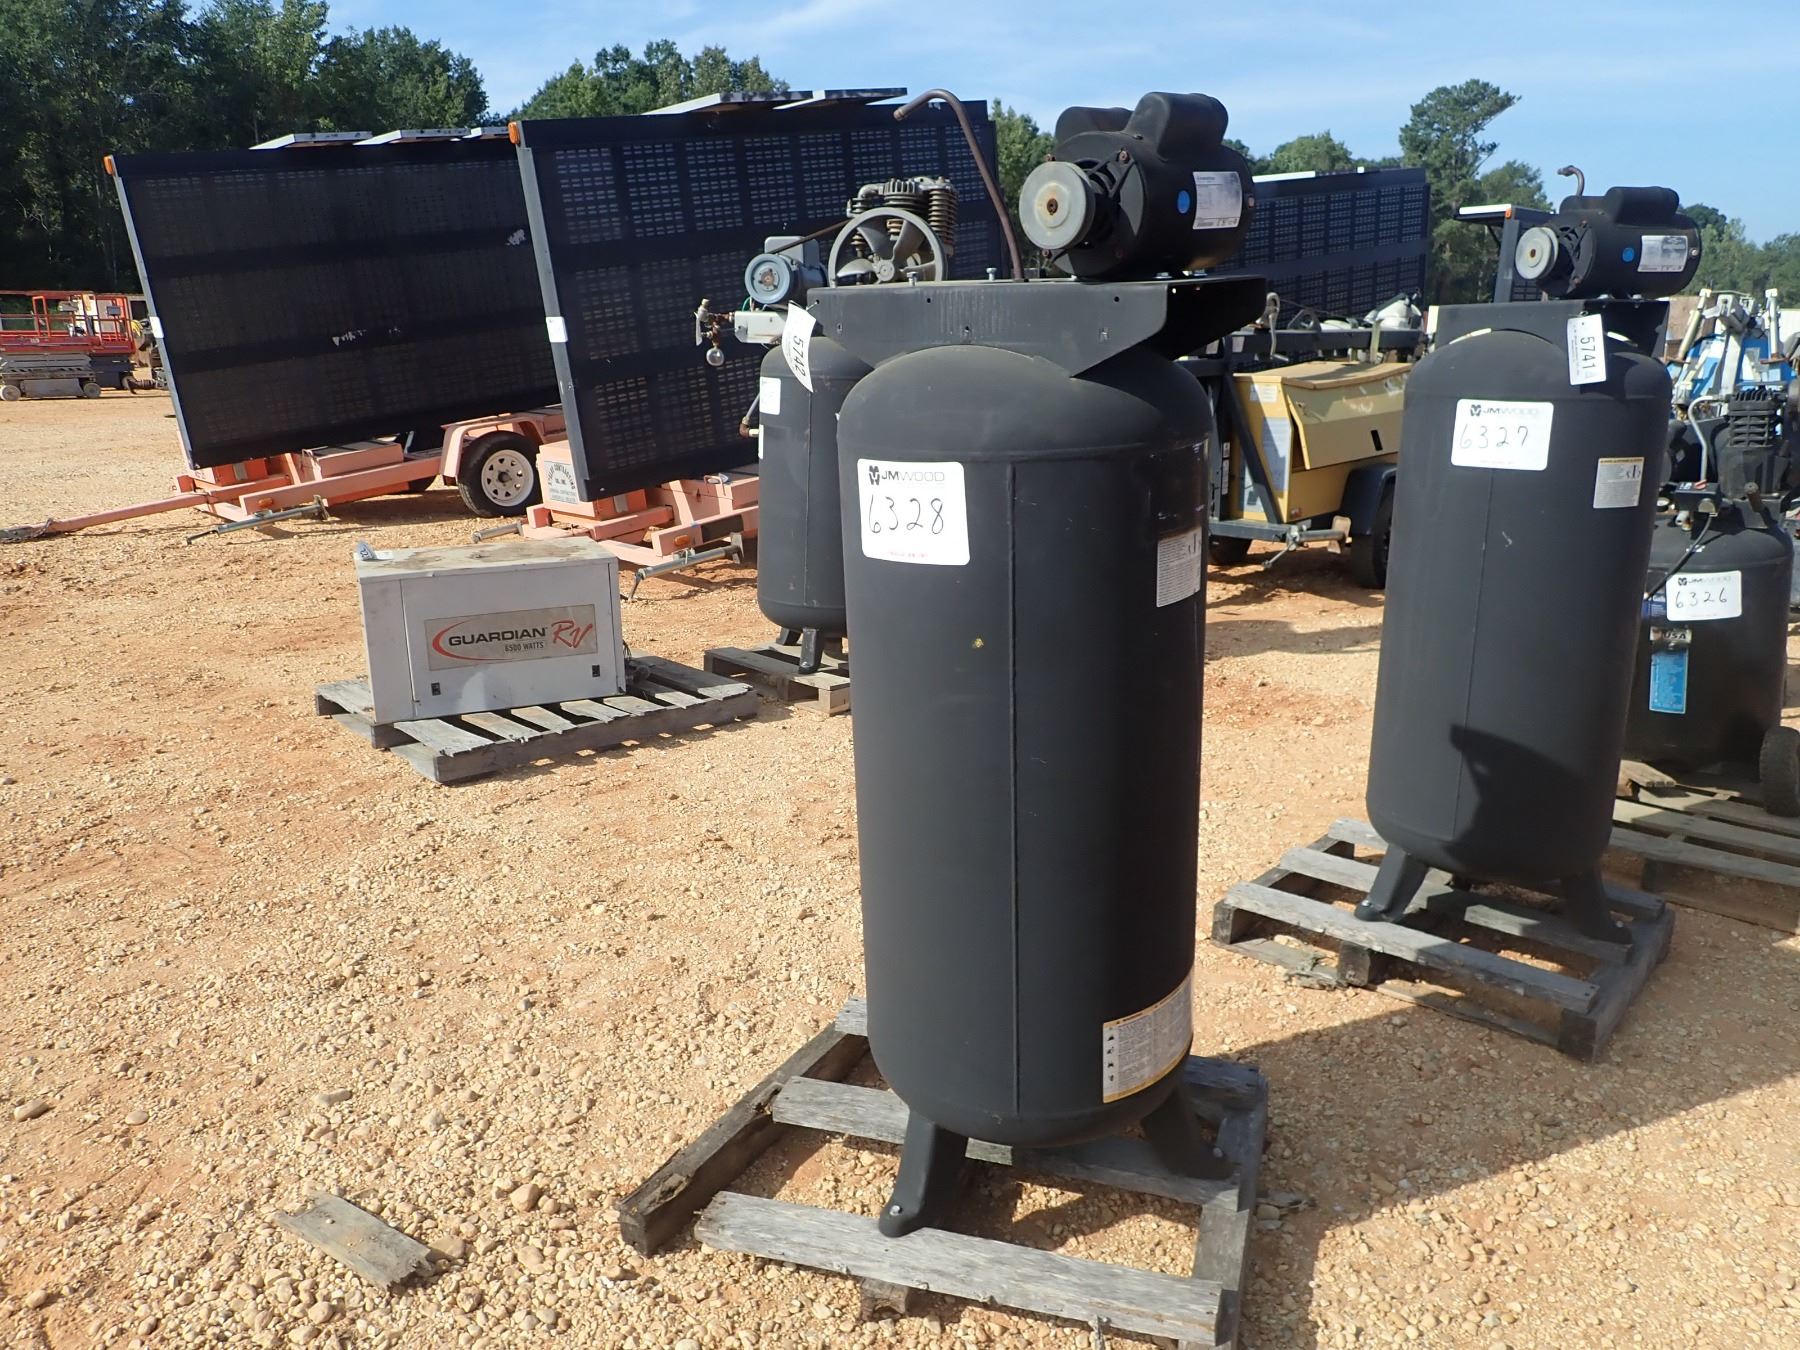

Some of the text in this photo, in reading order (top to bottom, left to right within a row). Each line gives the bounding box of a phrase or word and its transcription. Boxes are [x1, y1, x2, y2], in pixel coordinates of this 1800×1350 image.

[793, 335, 806, 377] 5742
[1580, 336, 1596, 369] 5741
[1459, 423, 1529, 449] 6327
[881, 470, 945, 481] JMWOOD
[868, 494, 944, 535] 6328
[1675, 587, 1727, 608] 6326
[448, 620, 593, 649] GUARDIAN RV
[504, 641, 544, 652] 6500 WATTS
